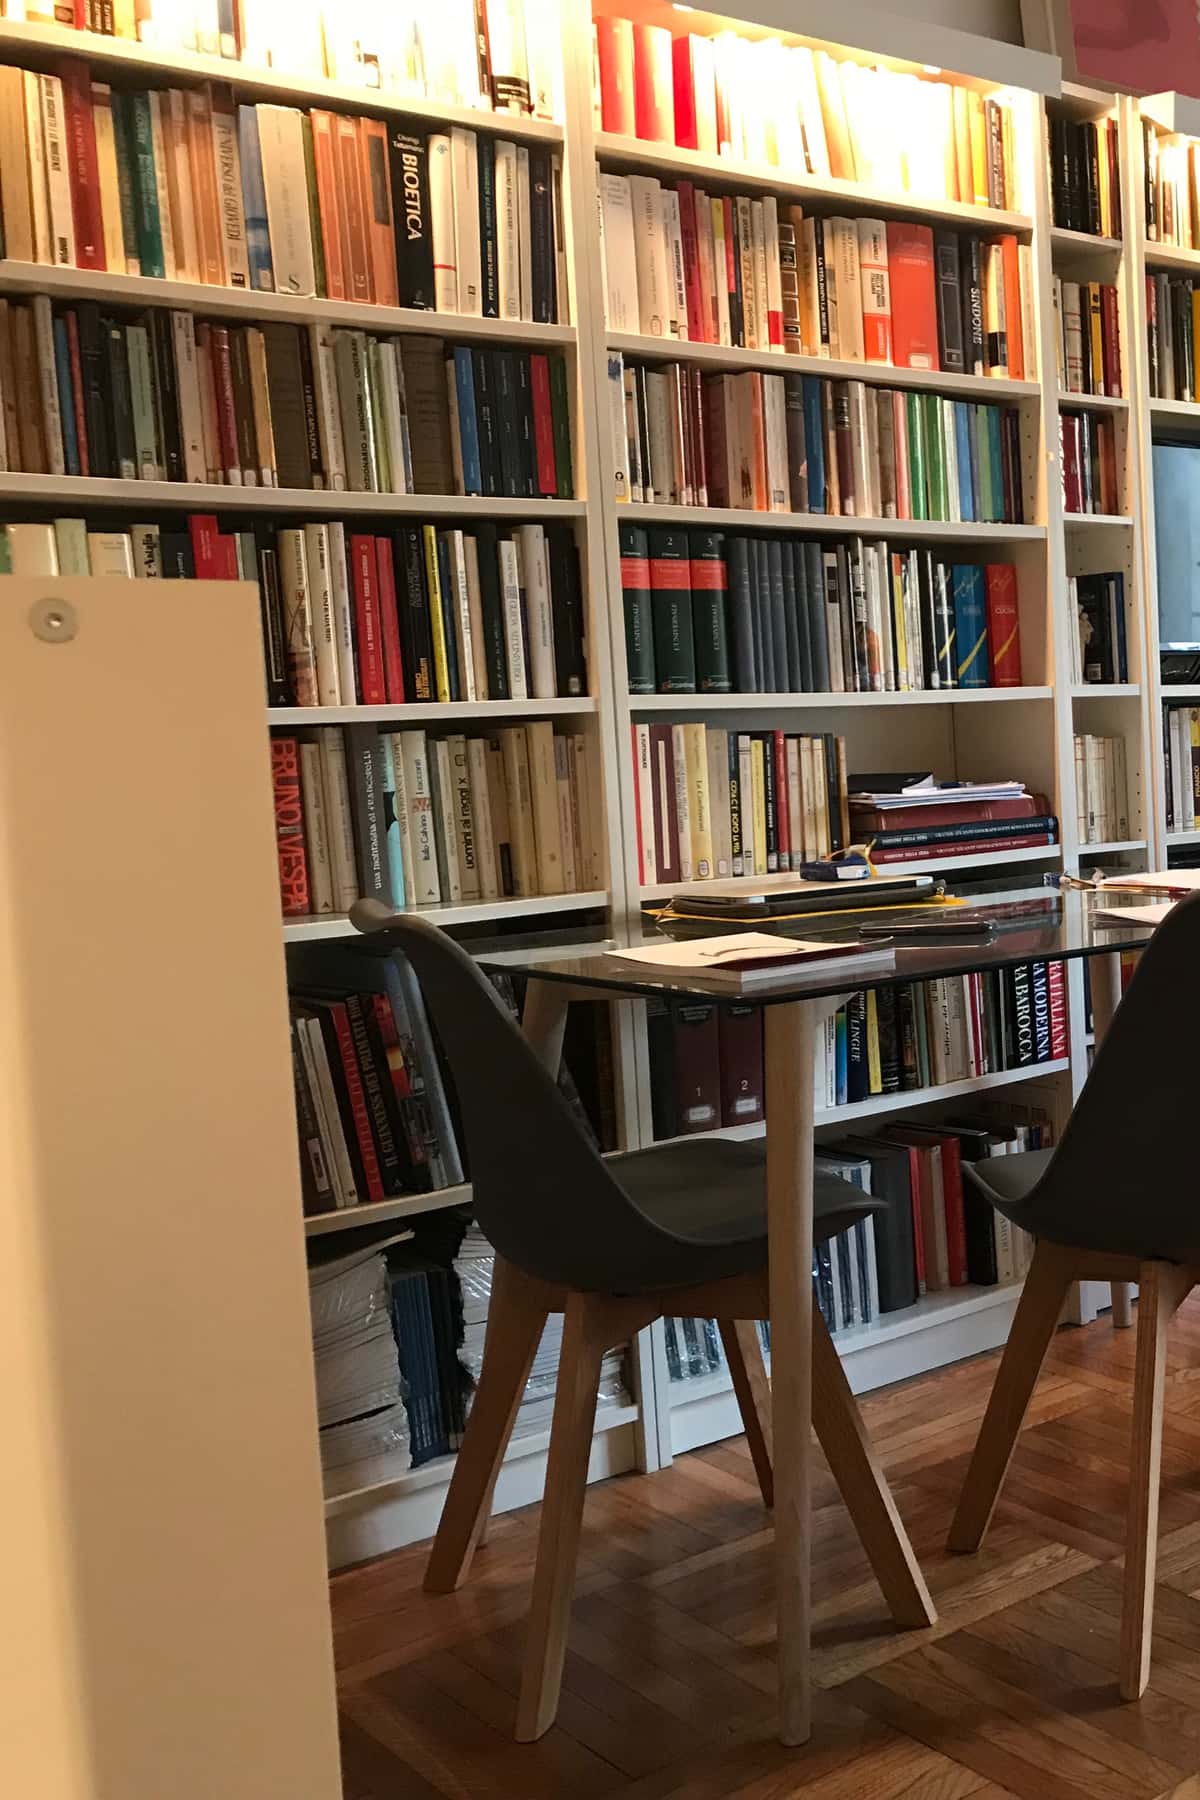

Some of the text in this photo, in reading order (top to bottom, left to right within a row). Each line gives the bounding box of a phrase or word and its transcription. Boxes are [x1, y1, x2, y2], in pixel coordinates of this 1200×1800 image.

[402, 152, 423, 240] BIOETICA
[969, 287, 983, 344] SINDONE
[271, 738, 308, 911] BRUNO VESPA
[1015, 983, 1032, 1062] BAROCCA
[1033, 978, 1049, 1059] MODERNA
[1050, 984, 1066, 1055] ITALIANA
[740, 1080, 749, 1090] 2
